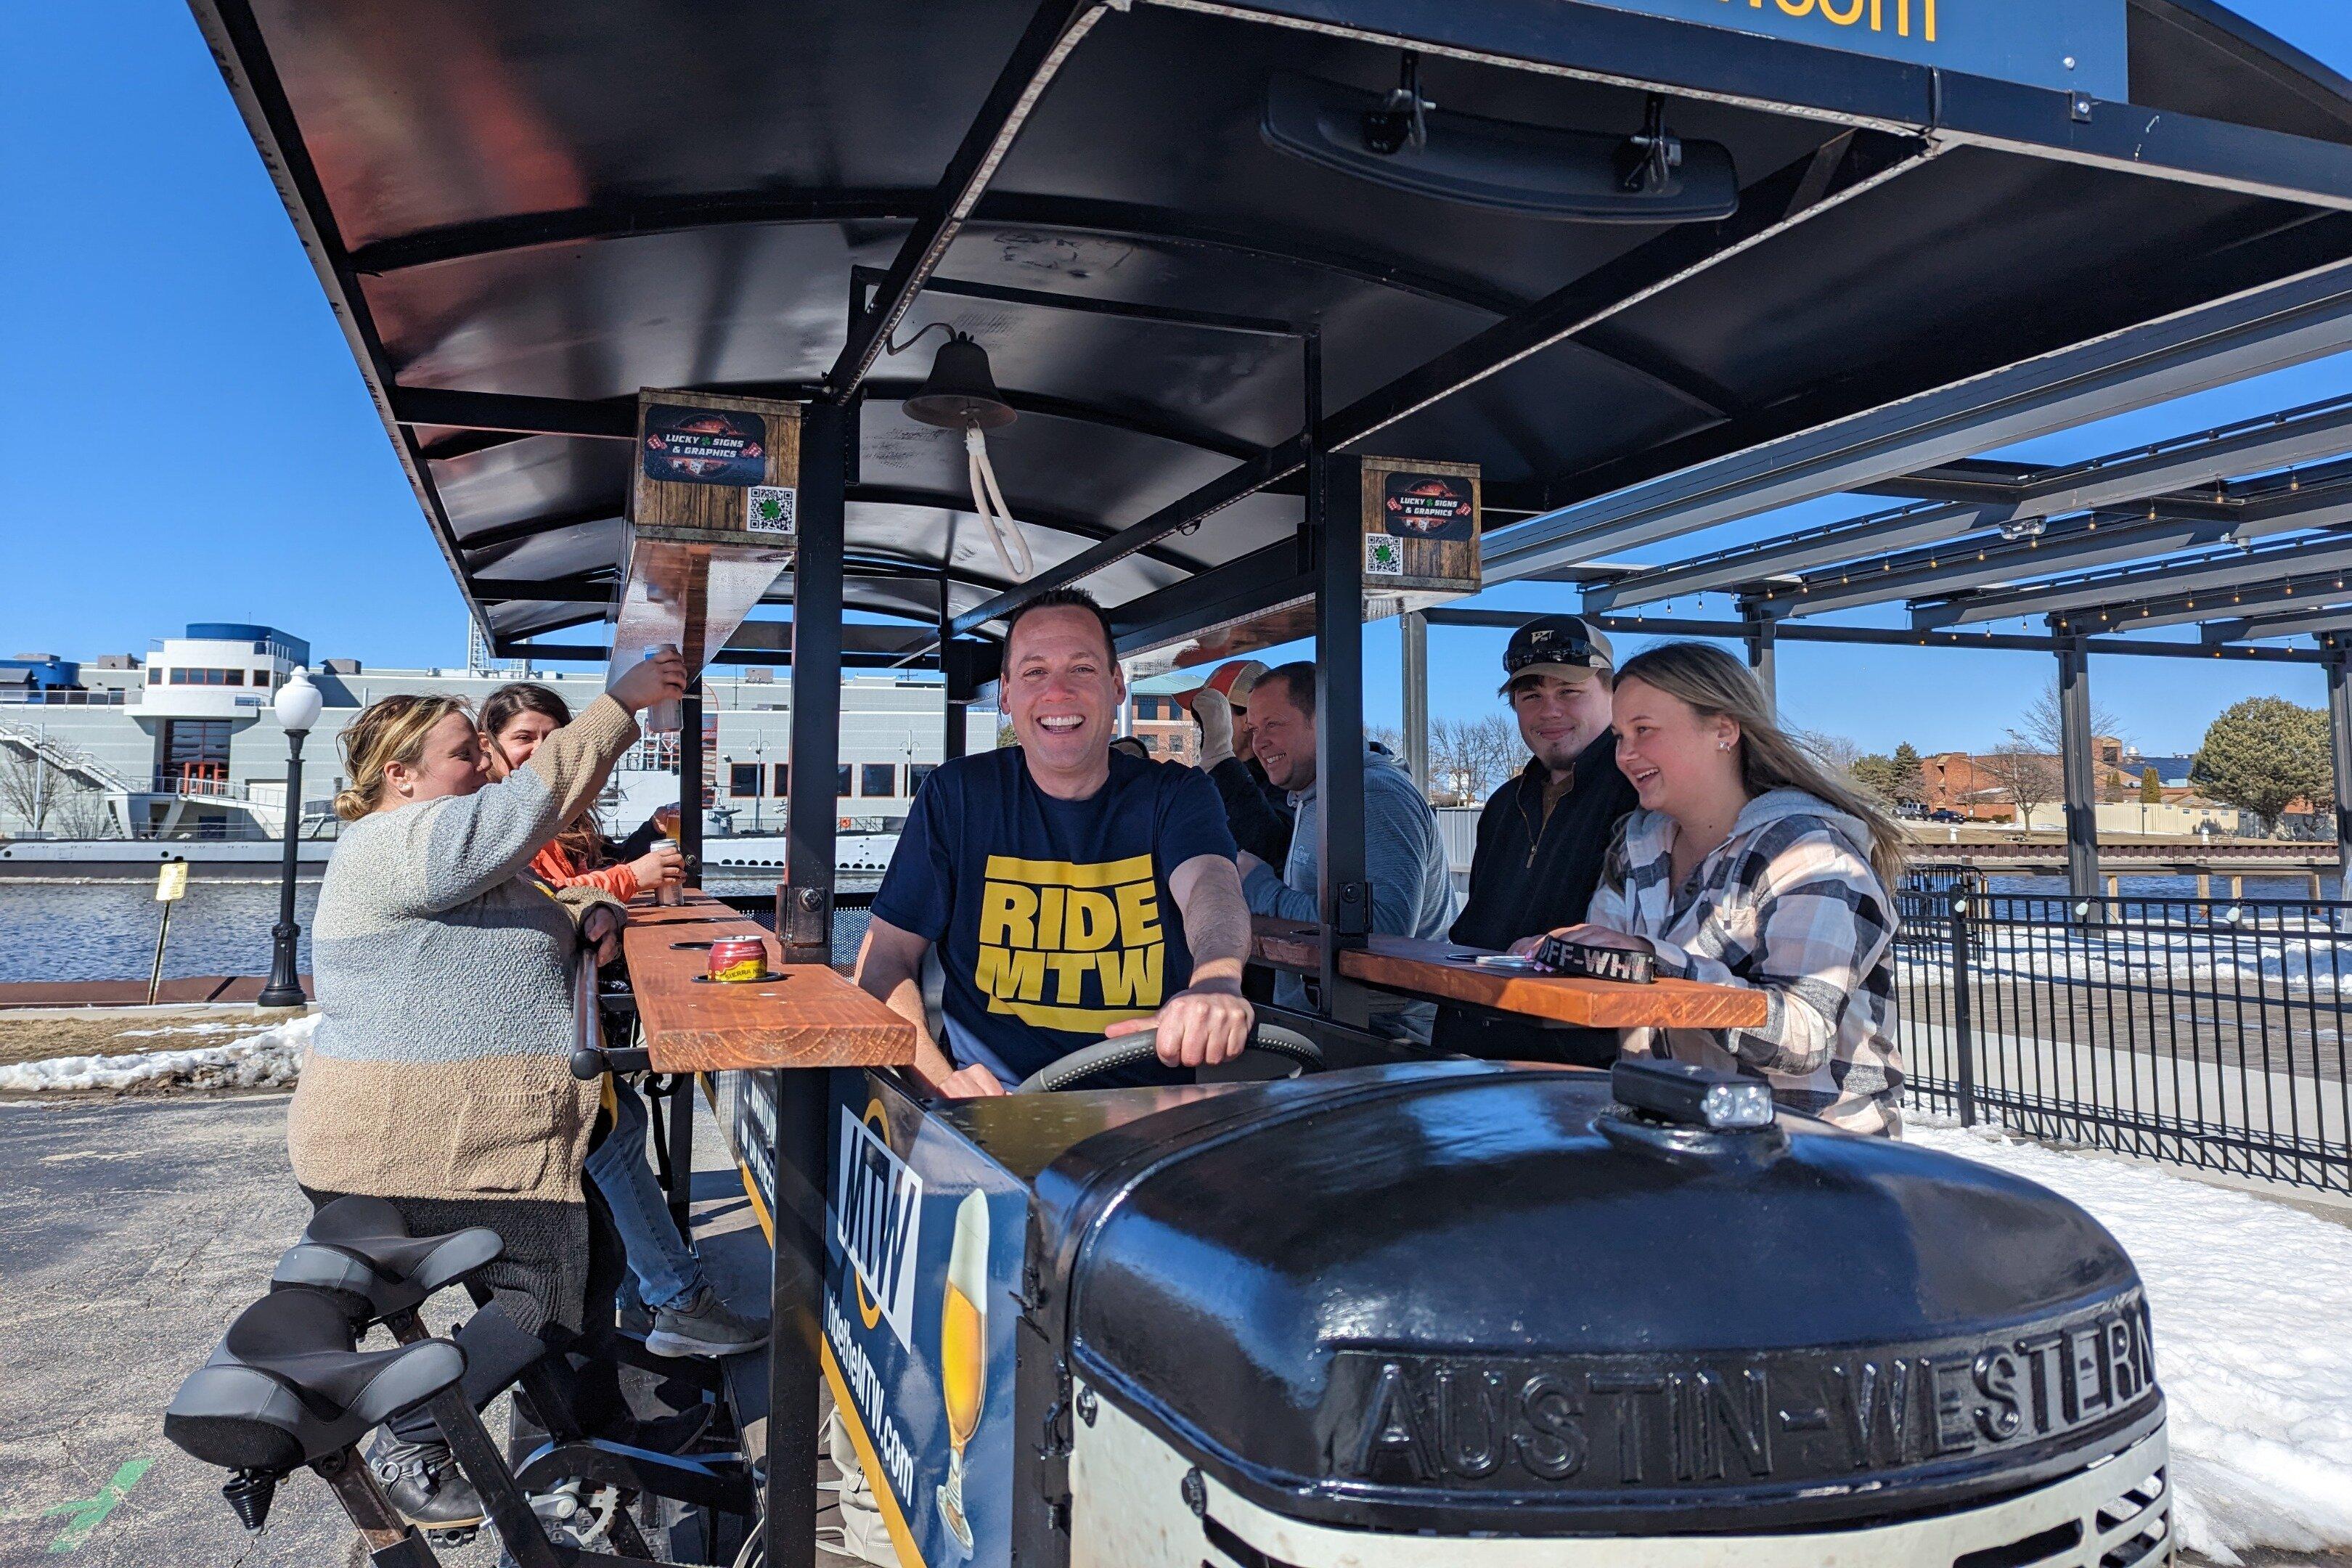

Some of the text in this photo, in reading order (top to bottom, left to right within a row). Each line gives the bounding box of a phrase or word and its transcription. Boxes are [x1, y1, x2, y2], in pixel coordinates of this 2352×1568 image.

[666, 434, 744, 447] LUCKY SIGNS
[685, 447, 737, 457] GRAPHICS
[1414, 507, 1453, 516] GRAPHICS
[979, 879, 1164, 952] RIDE
[725, 969, 751, 980] SIERRA
[975, 942, 1165, 1007] MTW
[840, 1119, 918, 1323] MTW
[828, 1291, 914, 1508] ridetheMTW.com
